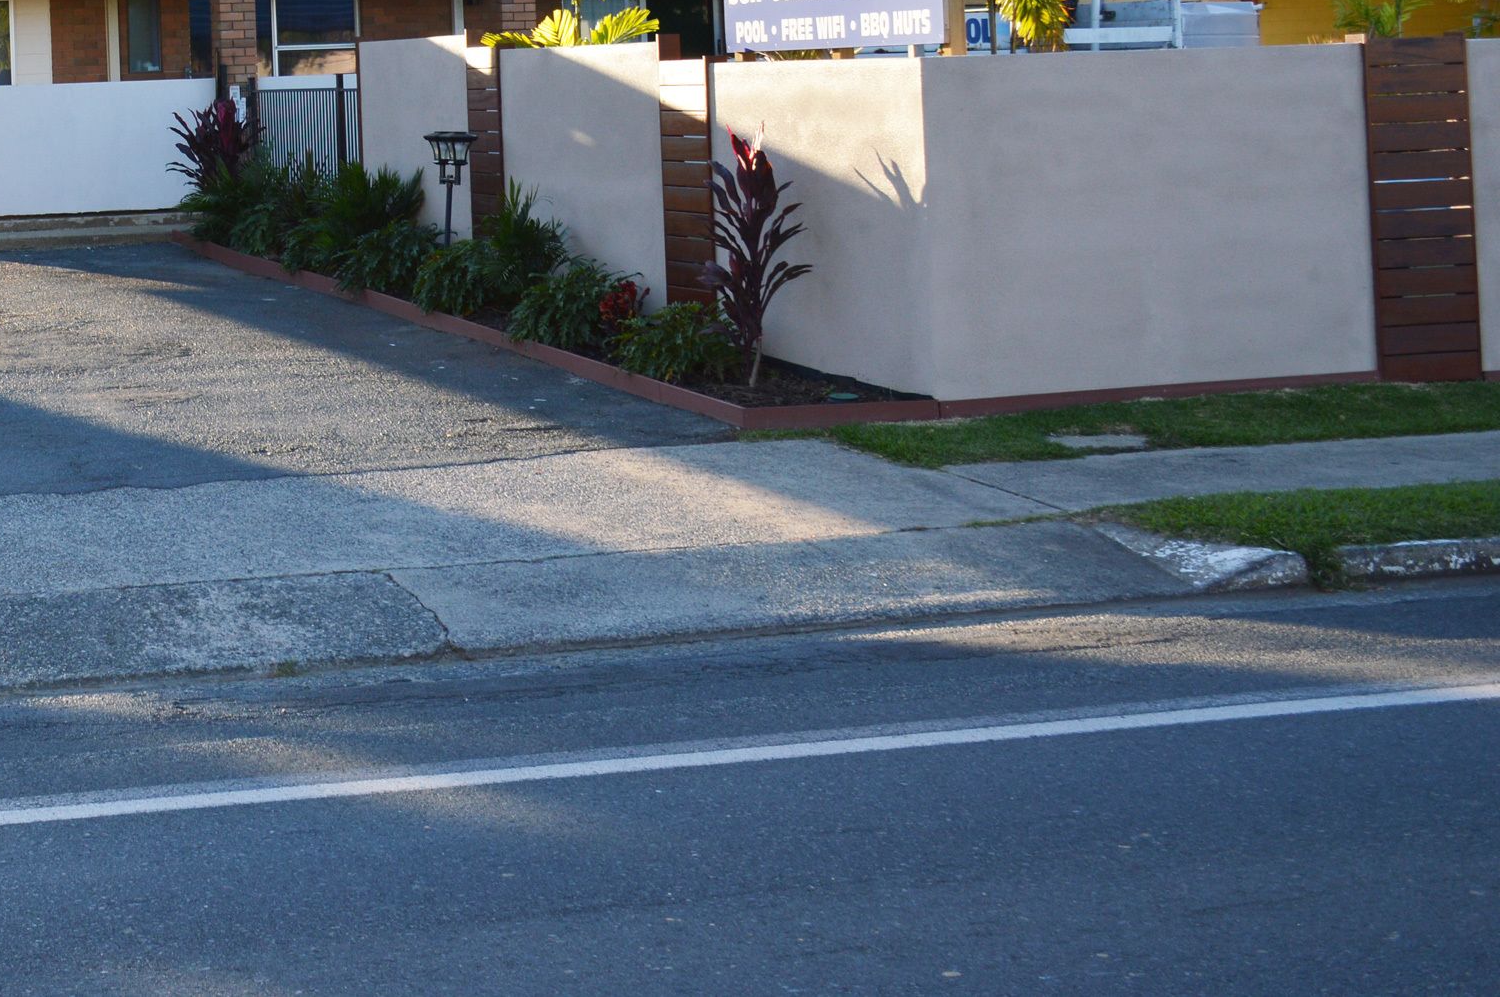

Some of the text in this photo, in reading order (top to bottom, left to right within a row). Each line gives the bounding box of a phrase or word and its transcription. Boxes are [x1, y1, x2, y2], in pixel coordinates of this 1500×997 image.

[735, 8, 931, 43] POOL FREE WIFI BBQ HUTS
